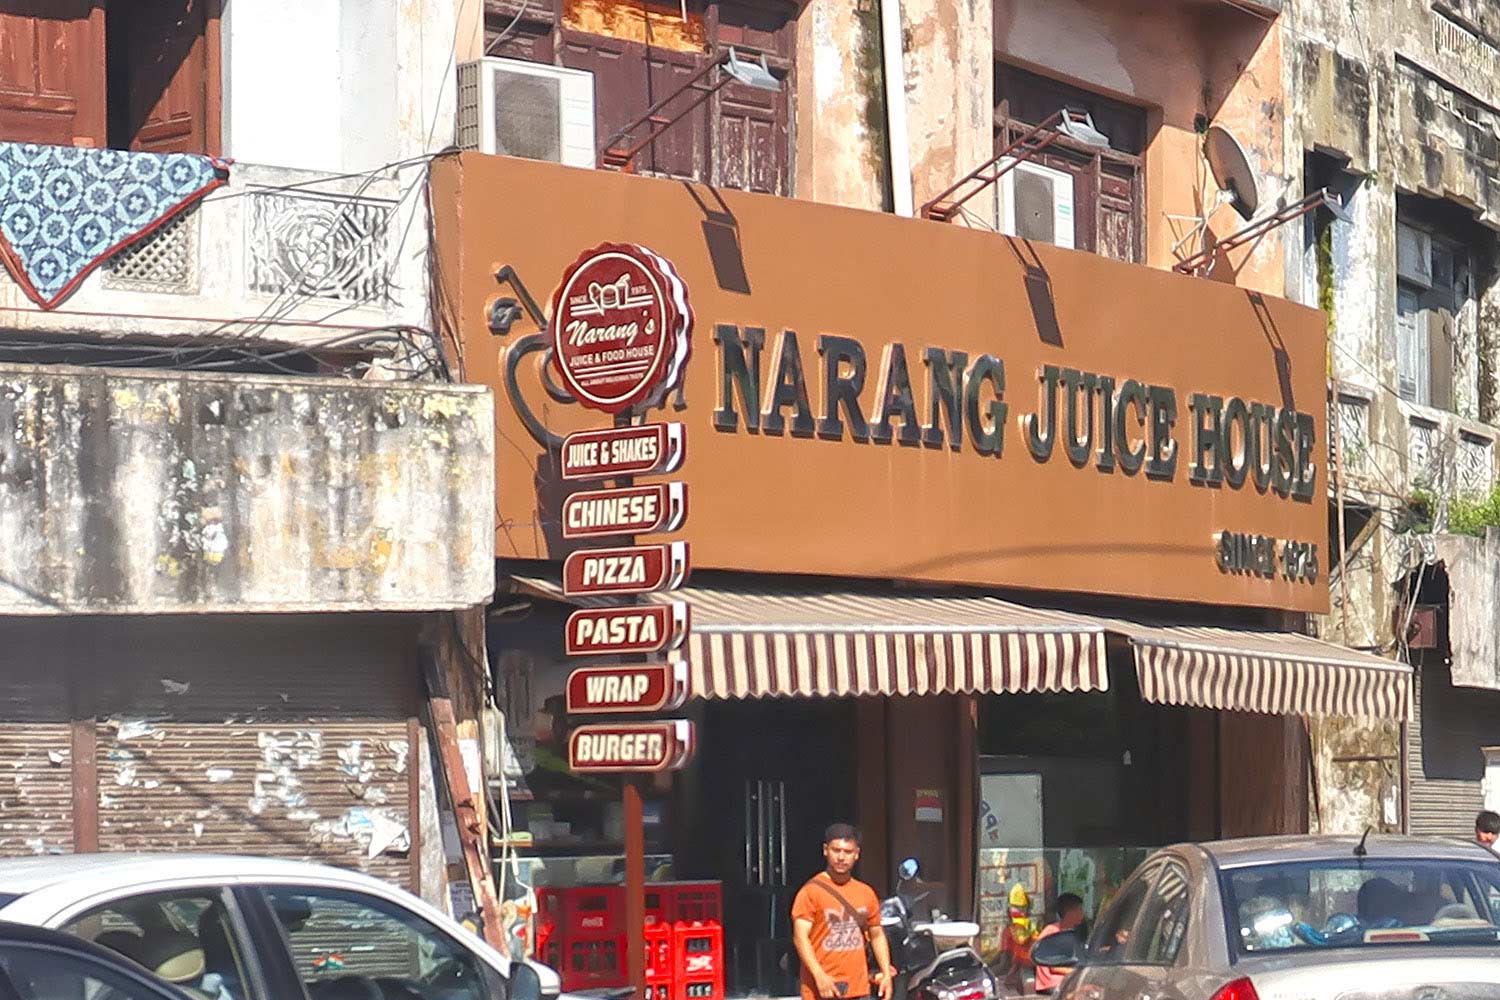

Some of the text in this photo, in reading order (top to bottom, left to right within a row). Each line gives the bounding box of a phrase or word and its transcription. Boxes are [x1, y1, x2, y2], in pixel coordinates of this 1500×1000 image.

[570, 285, 647, 305] SINCE 1975
[565, 310, 655, 347] Narang's
[569, 345, 655, 367] JUICE & FOOD HOUSE
[712, 323, 1317, 505] NARANG JUICE HOUSE
[567, 436, 657, 468] JUICE & SHAKES
[568, 494, 658, 529] CHINESE
[582, 555, 646, 586] PIZZA
[1212, 529, 1318, 585] SINCE 1975
[576, 615, 658, 646] PASTA
[586, 674, 650, 704] WRAP
[577, 733, 663, 762] BURGER
